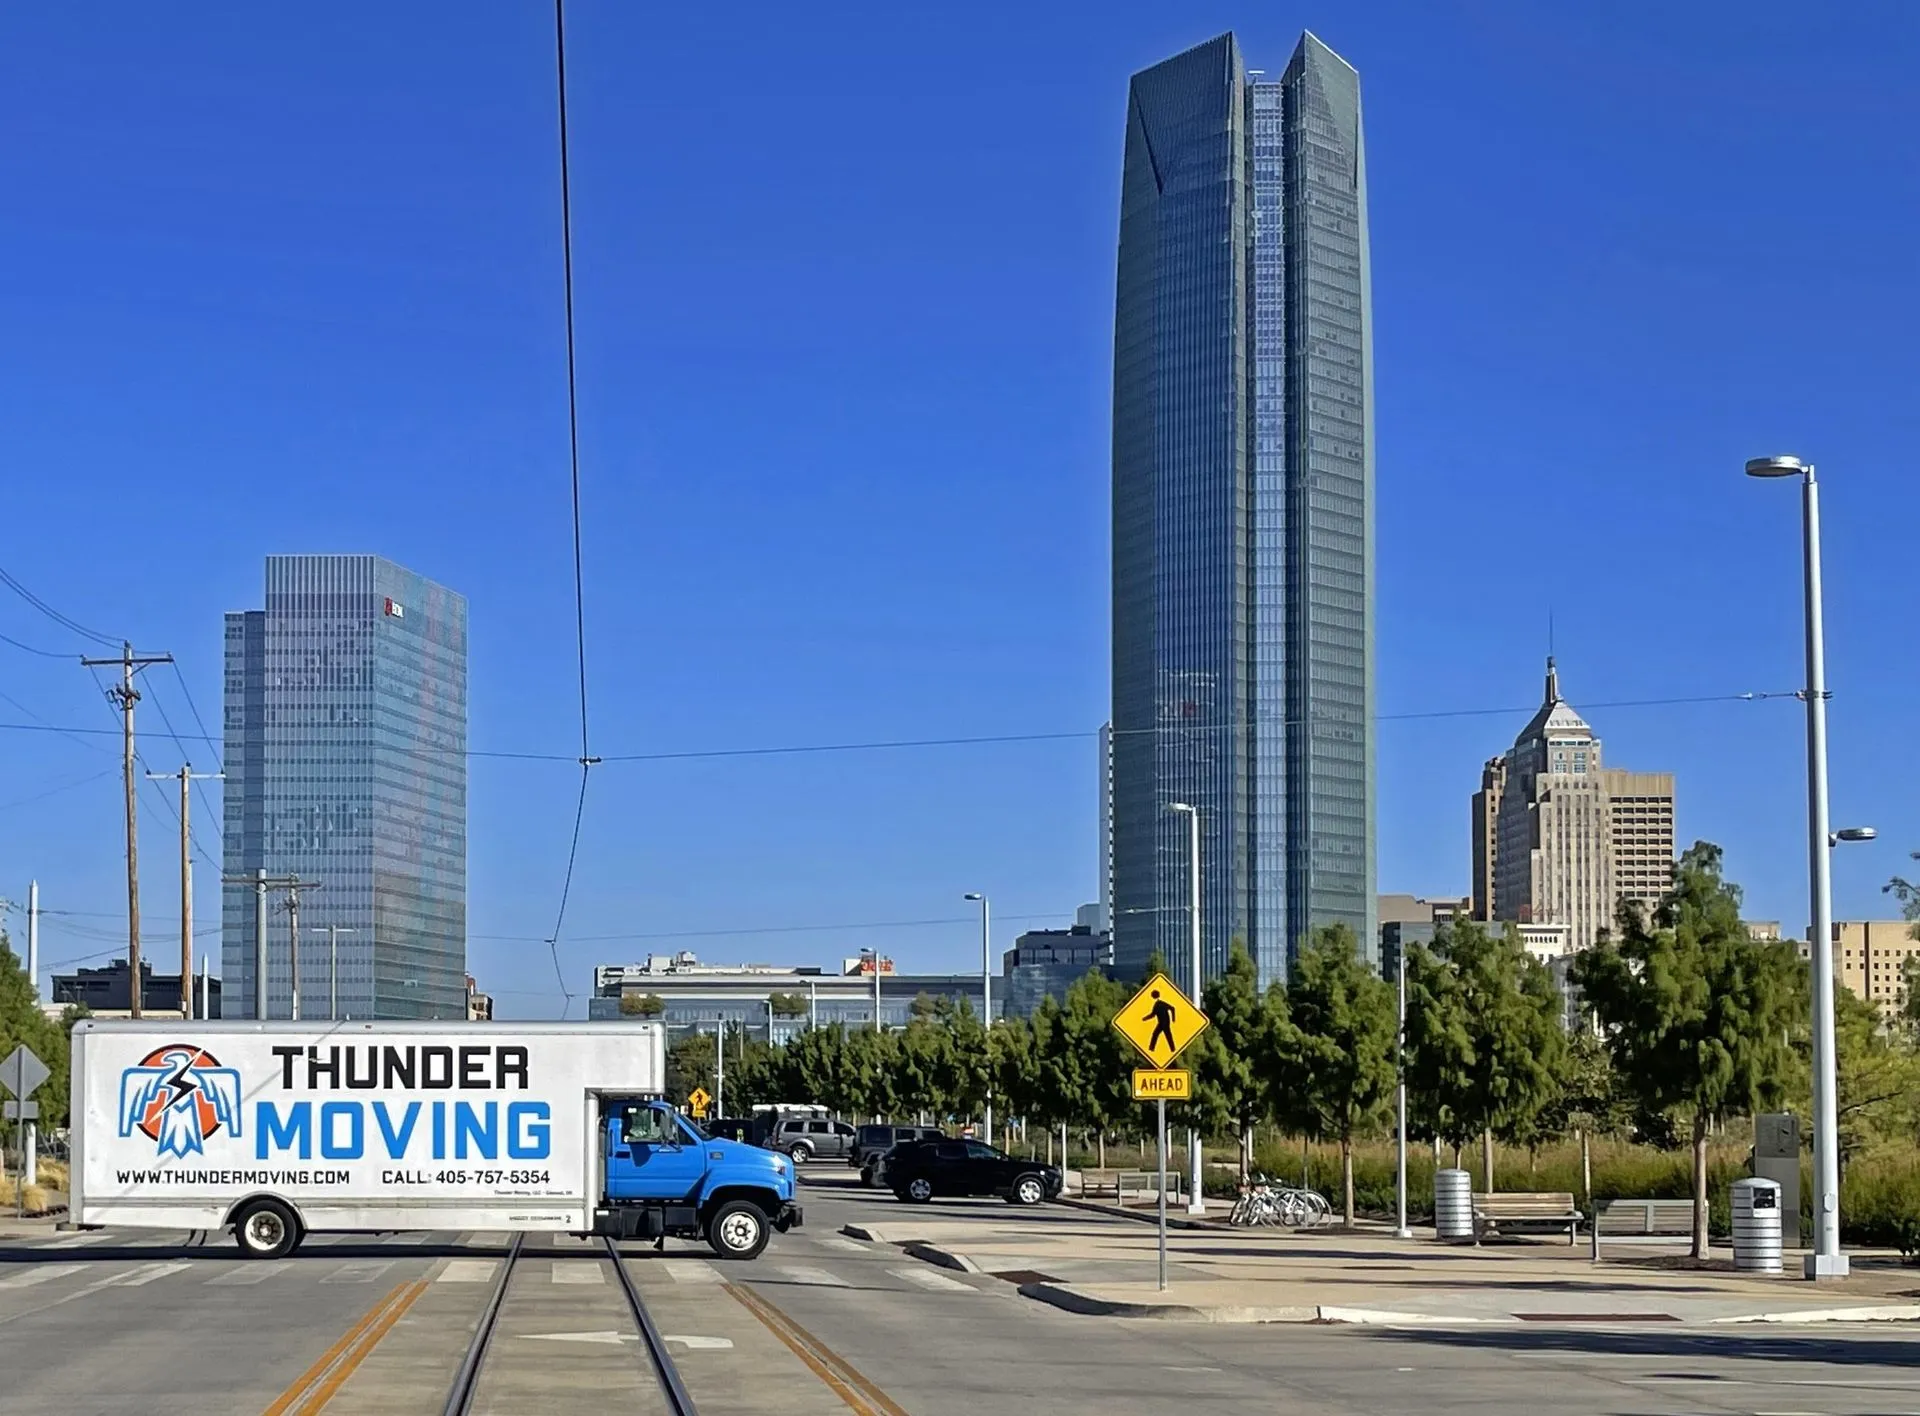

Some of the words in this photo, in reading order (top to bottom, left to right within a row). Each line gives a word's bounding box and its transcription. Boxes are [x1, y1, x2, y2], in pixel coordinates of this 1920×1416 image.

[272, 1046, 528, 1089] THUNDER
[1140, 1078, 1183, 1091] AHEAD
[256, 1101, 550, 1160] MOVING
[116, 1170, 350, 1184] WWW.THUNDERMOVING.COM
[382, 1170, 432, 1184] CALL:
[436, 1170, 550, 1184] 405-757-5354
